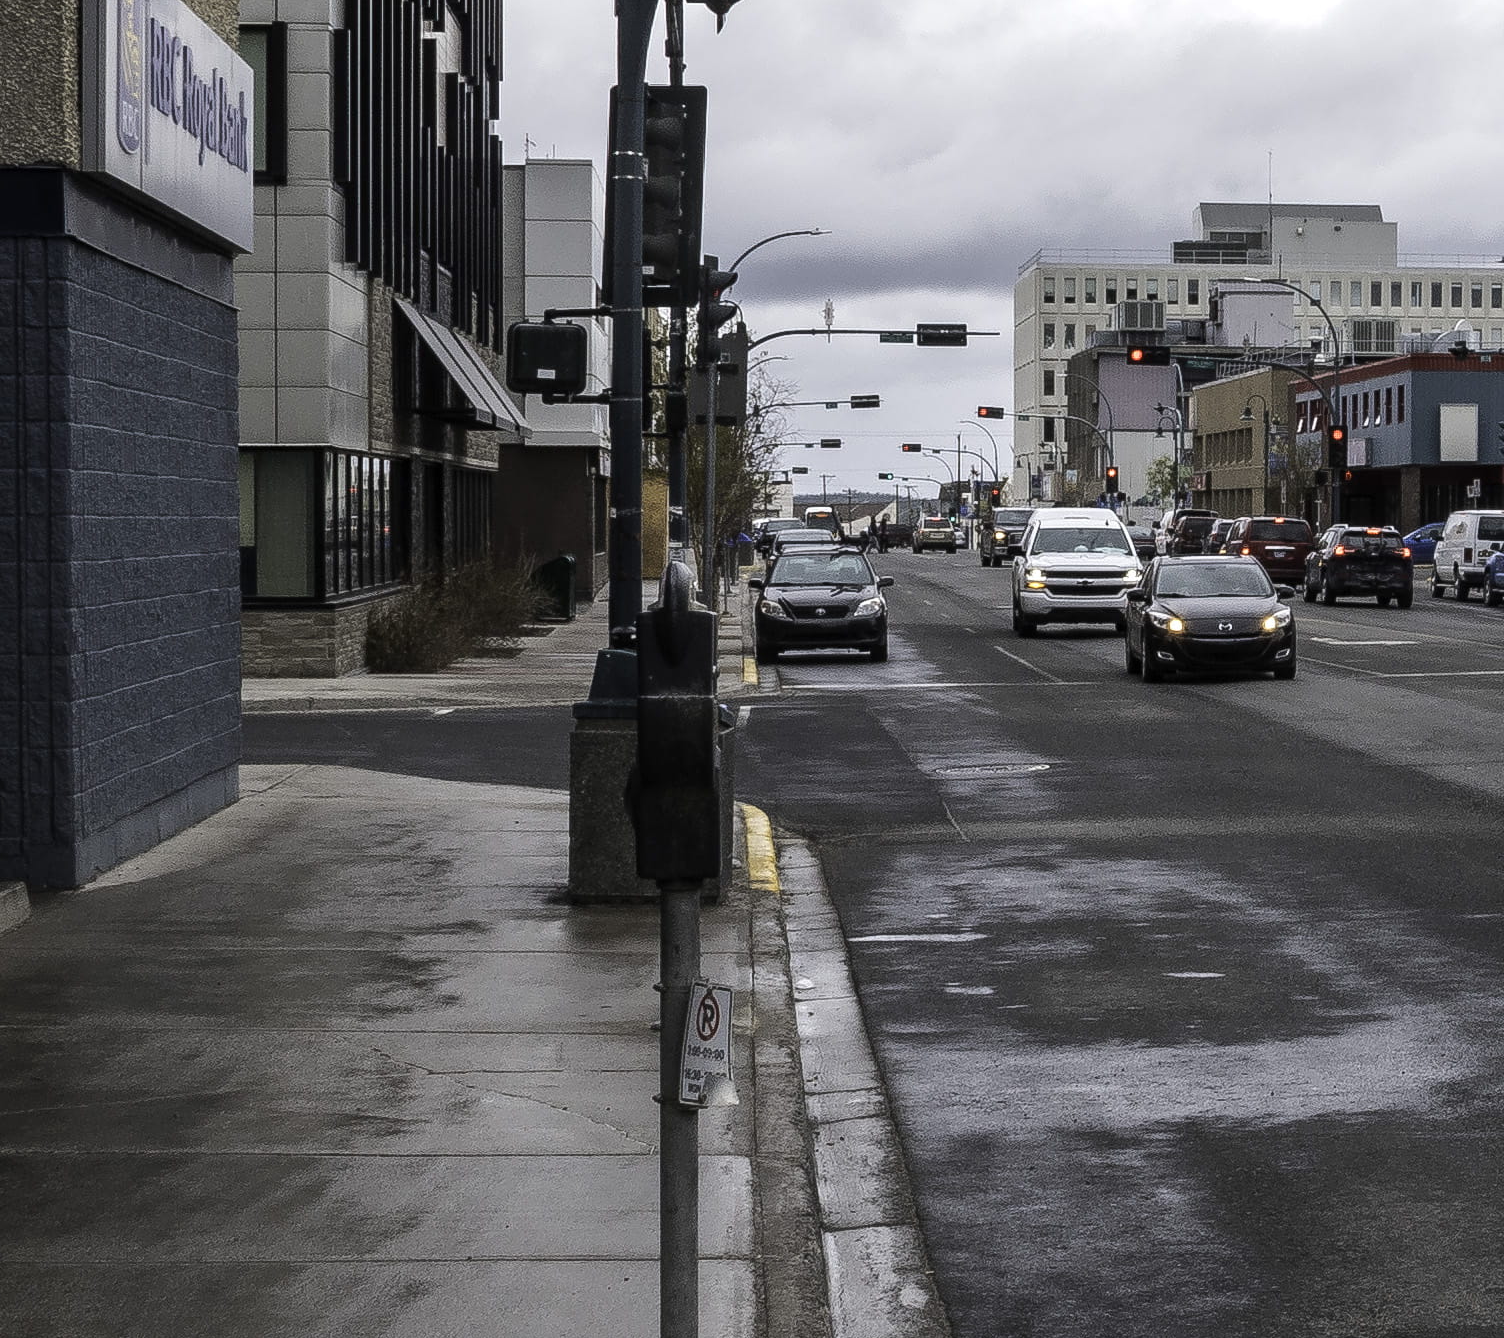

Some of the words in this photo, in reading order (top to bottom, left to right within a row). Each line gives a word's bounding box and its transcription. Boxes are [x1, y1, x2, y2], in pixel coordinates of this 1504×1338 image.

[151, 17, 182, 126] RBC
[182, 45, 218, 167] Royal
[219, 76, 248, 174] Bank
